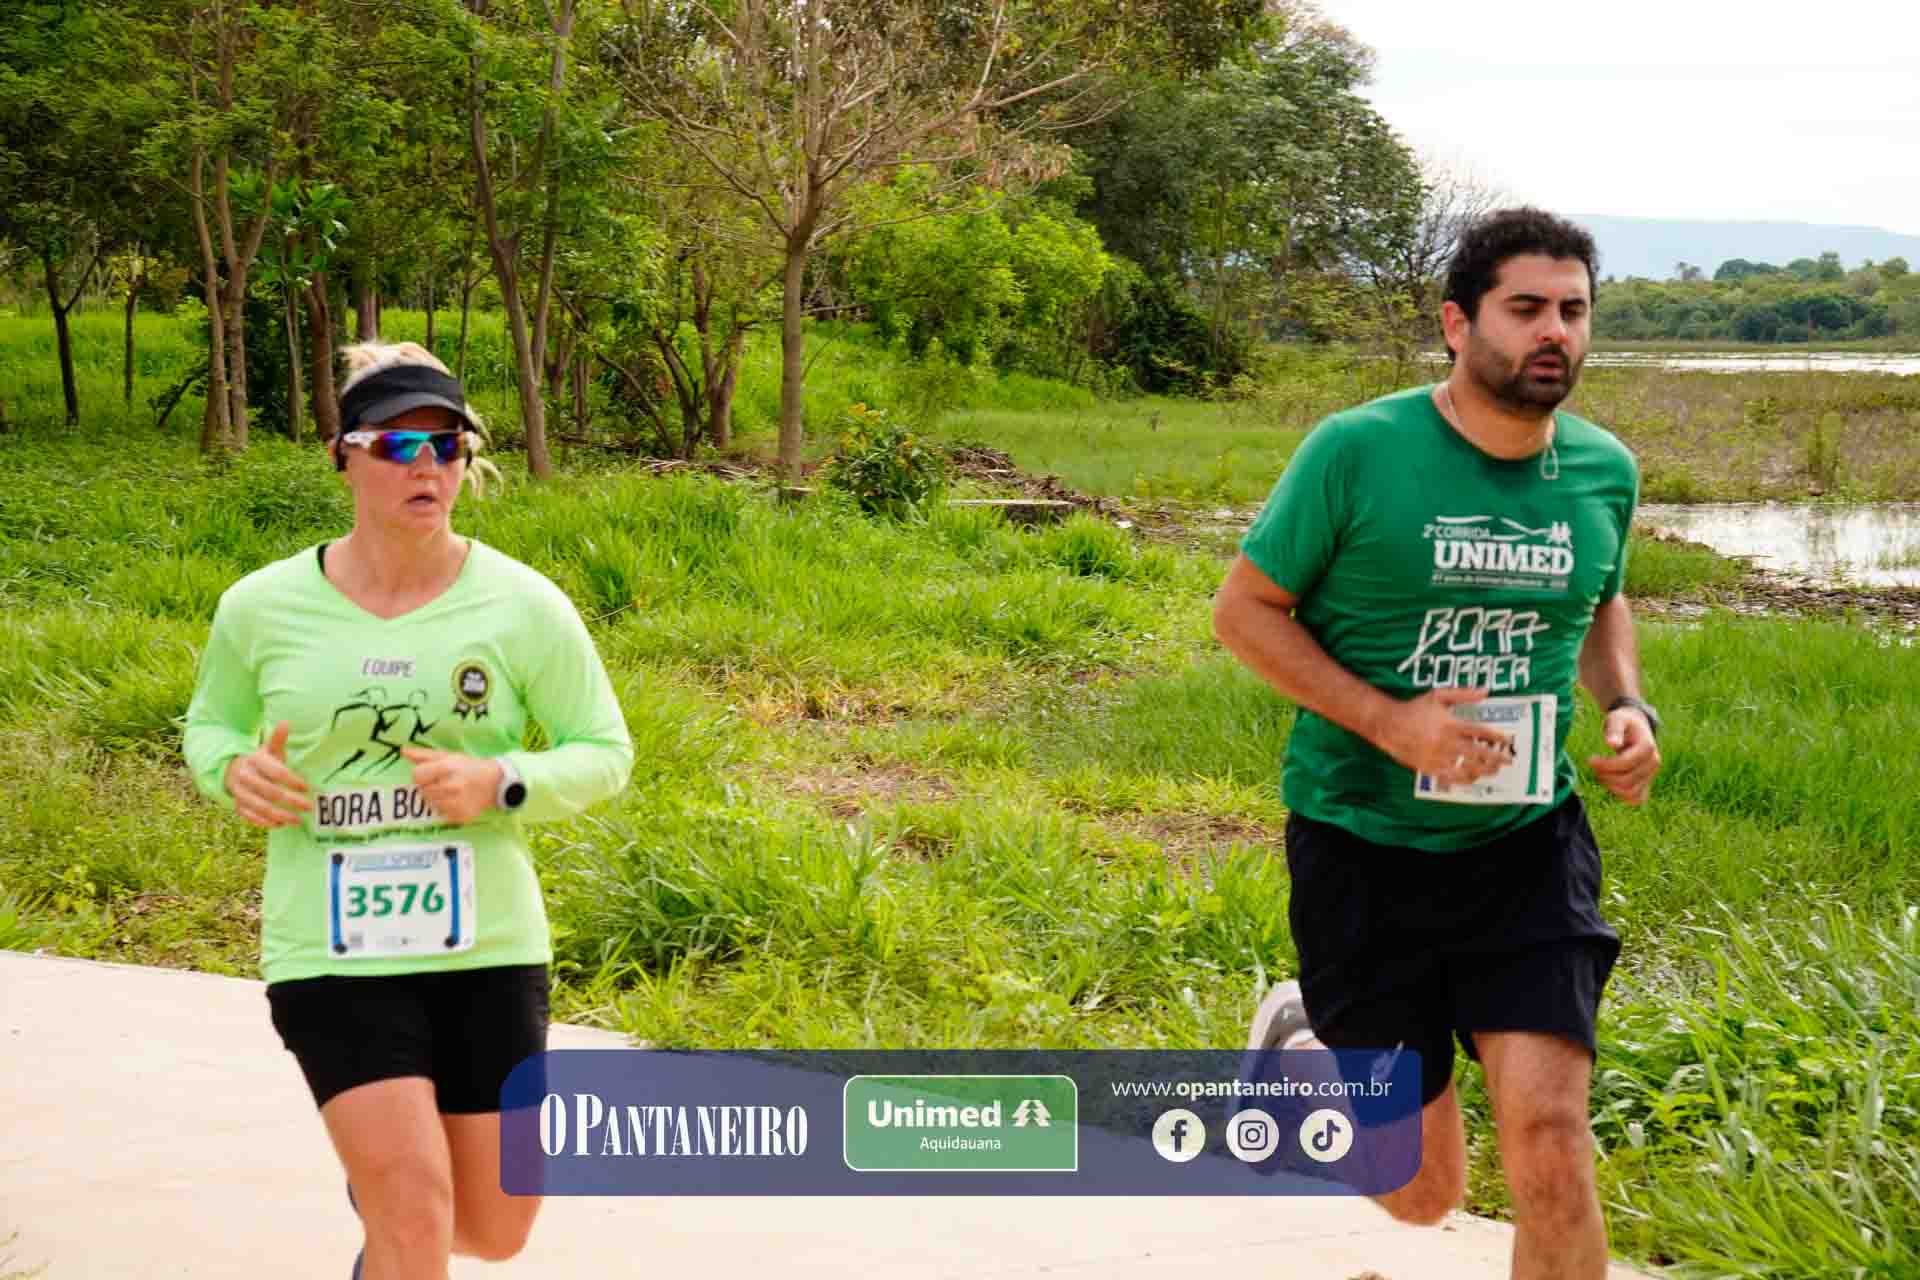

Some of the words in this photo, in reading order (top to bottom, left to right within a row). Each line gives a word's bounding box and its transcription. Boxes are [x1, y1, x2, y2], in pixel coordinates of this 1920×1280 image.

[1433, 540, 1574, 576] UNIMED
[1397, 608, 1550, 672] BORA
[1412, 653, 1531, 692] CORRER
[317, 791, 383, 827] BORA
[345, 881, 446, 918] 3576
